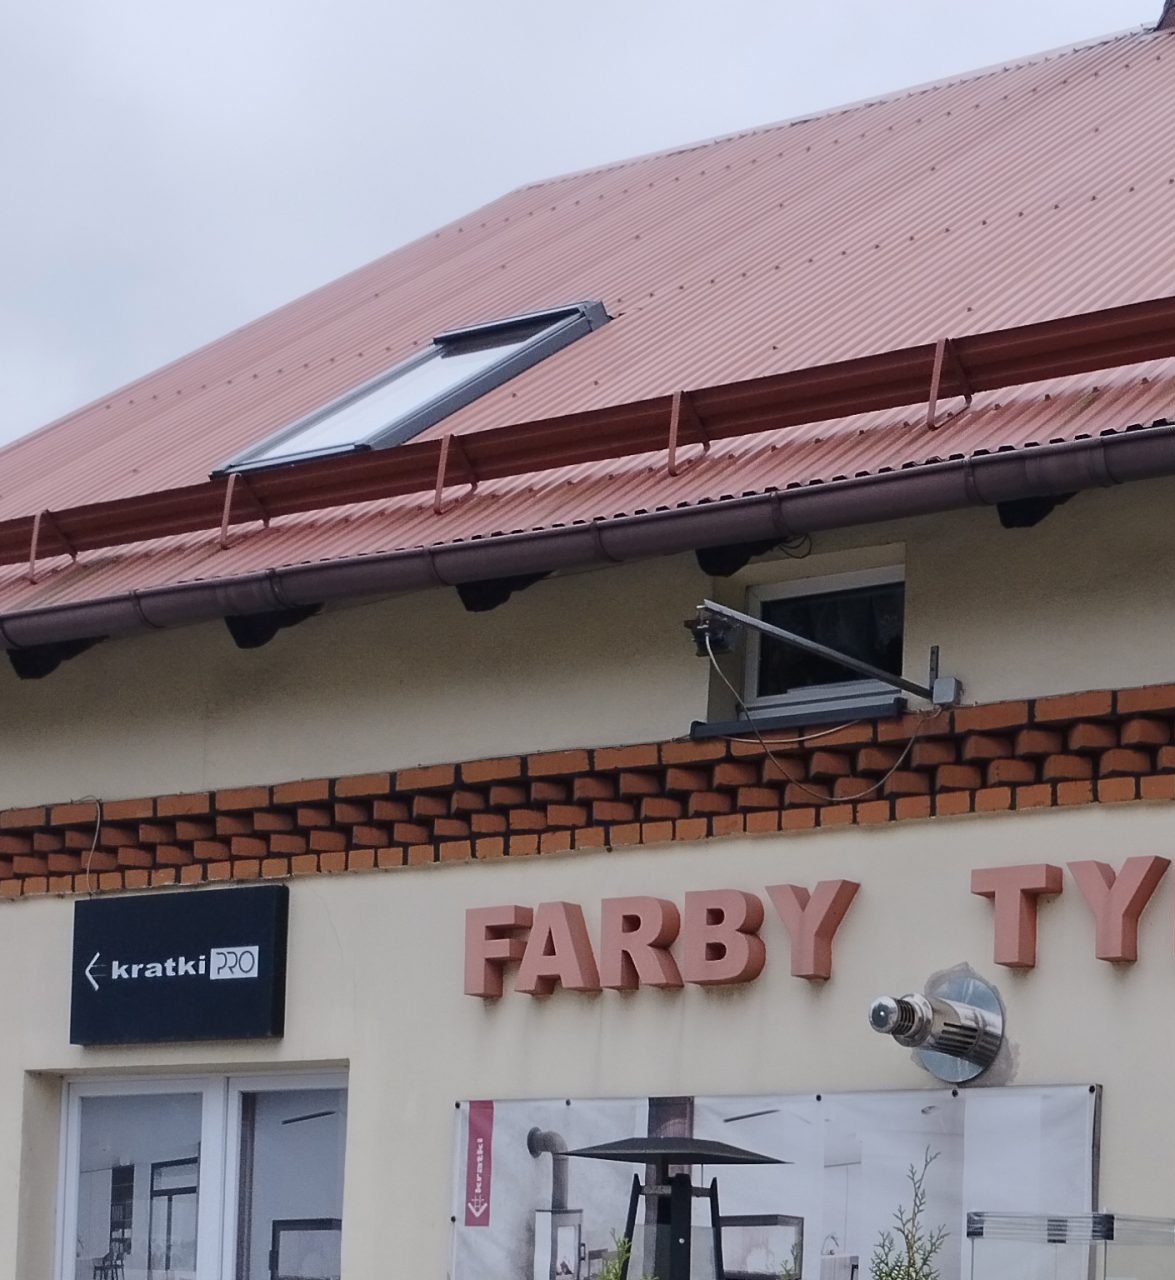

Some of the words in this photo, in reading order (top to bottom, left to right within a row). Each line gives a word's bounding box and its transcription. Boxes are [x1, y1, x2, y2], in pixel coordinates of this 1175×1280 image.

[464, 878, 861, 999] FARBY
[112, 955, 206, 979] kratki
[475, 1138, 484, 1193] kratki
